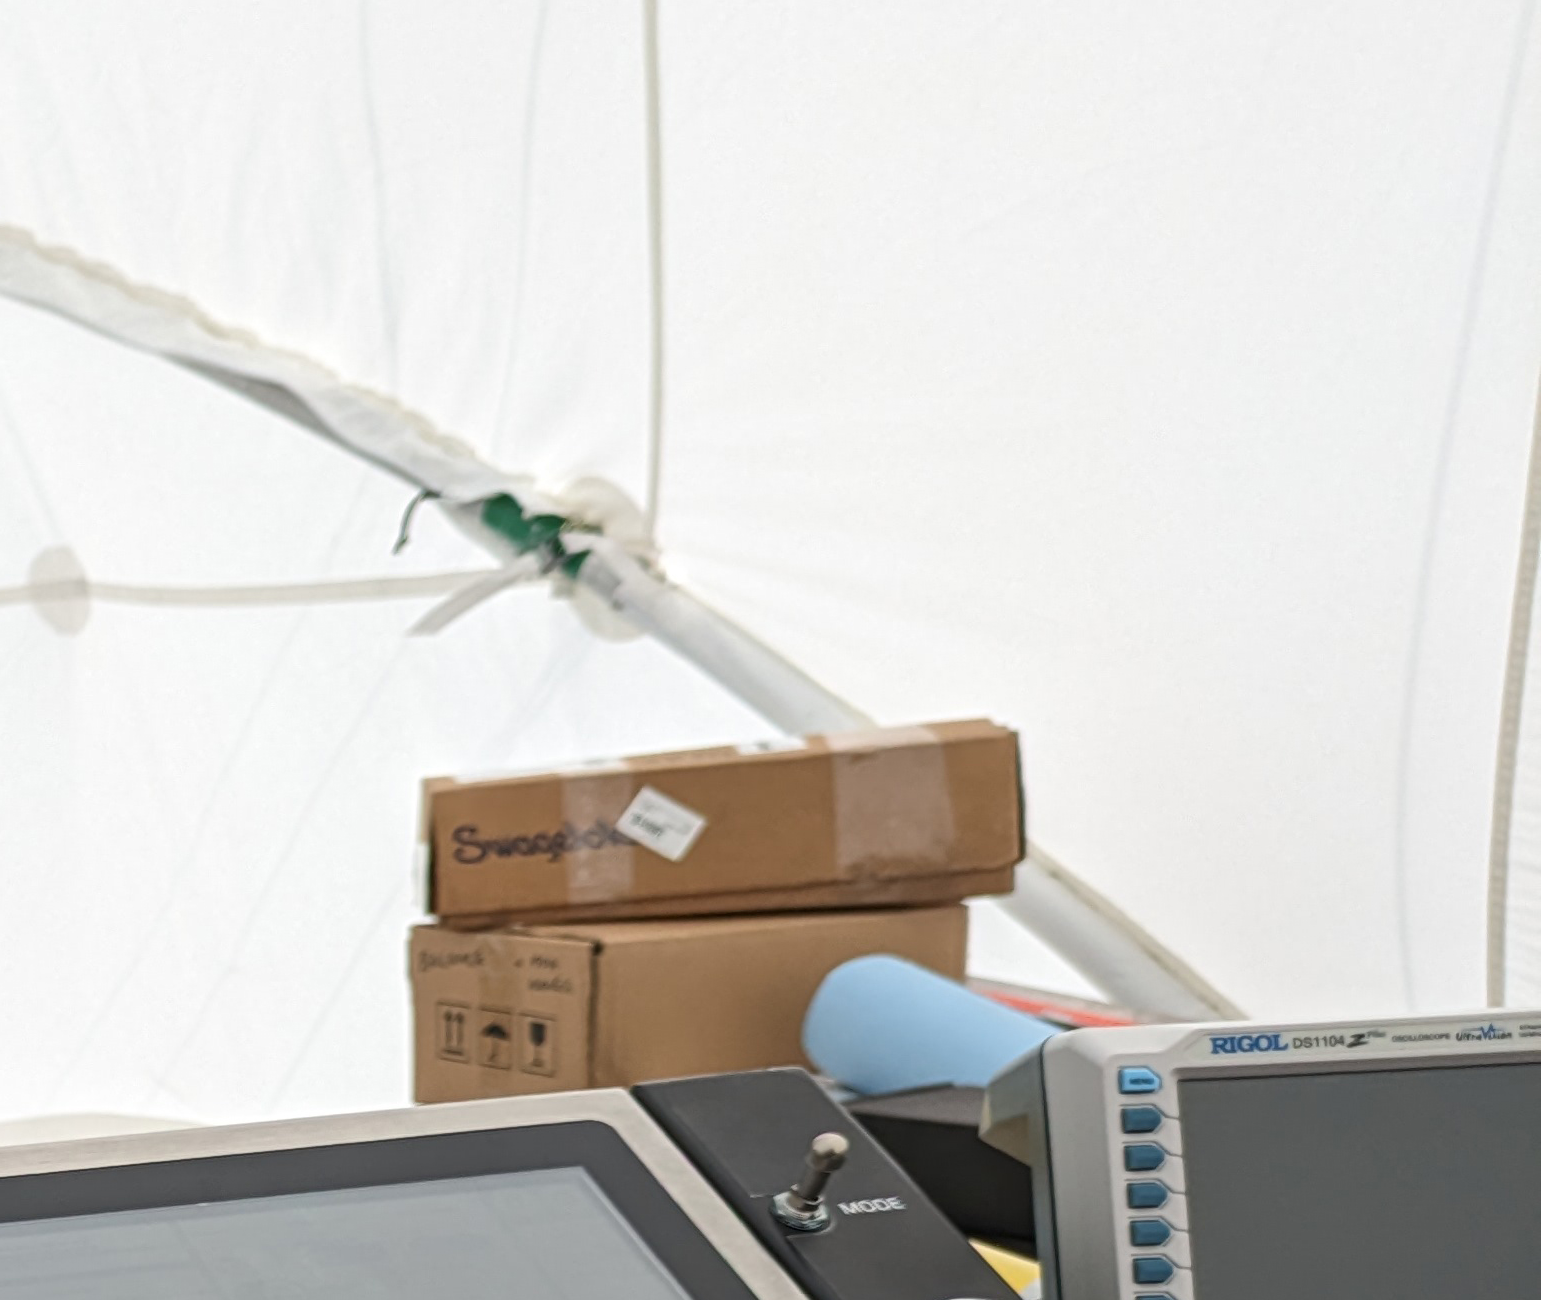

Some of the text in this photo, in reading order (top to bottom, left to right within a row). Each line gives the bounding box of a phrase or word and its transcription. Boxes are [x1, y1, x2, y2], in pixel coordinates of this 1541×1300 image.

[1209, 1033, 1289, 1055] RIGOL
[1292, 1035, 1345, 1049] DS1104
[838, 1196, 906, 1216] MODE
